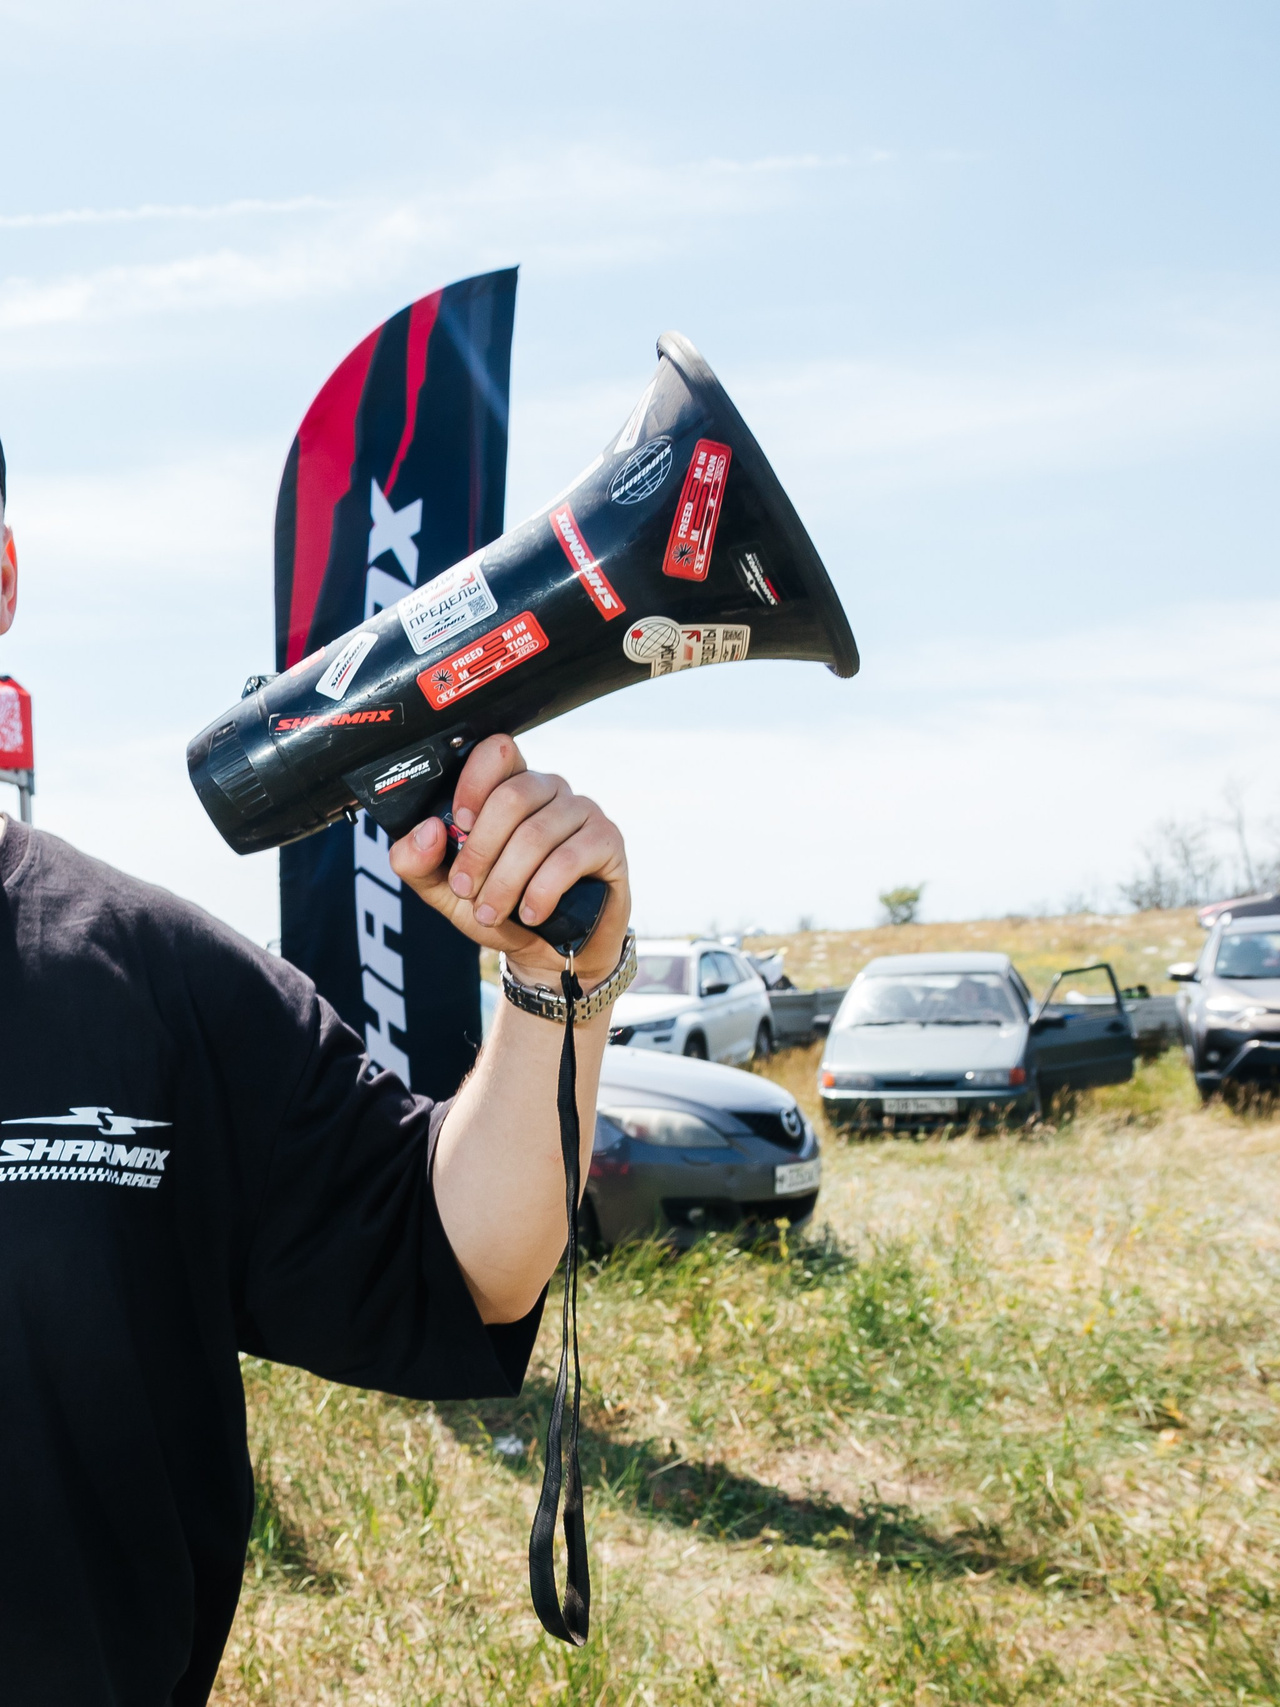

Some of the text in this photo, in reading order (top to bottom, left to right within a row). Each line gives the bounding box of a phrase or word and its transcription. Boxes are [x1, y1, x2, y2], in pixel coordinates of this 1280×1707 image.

[697, 452, 707, 462] IN
[610, 443, 672, 501] SHARMAX
[555, 511, 619, 610] SHARMAX
[409, 584, 482, 629] ПРЕДЕЛЫ
[515, 621, 527, 634] IN
[275, 709, 394, 731] SHARMAX
[374, 759, 430, 792] SHARMAX
[119, 1171, 162, 1189] RACE
